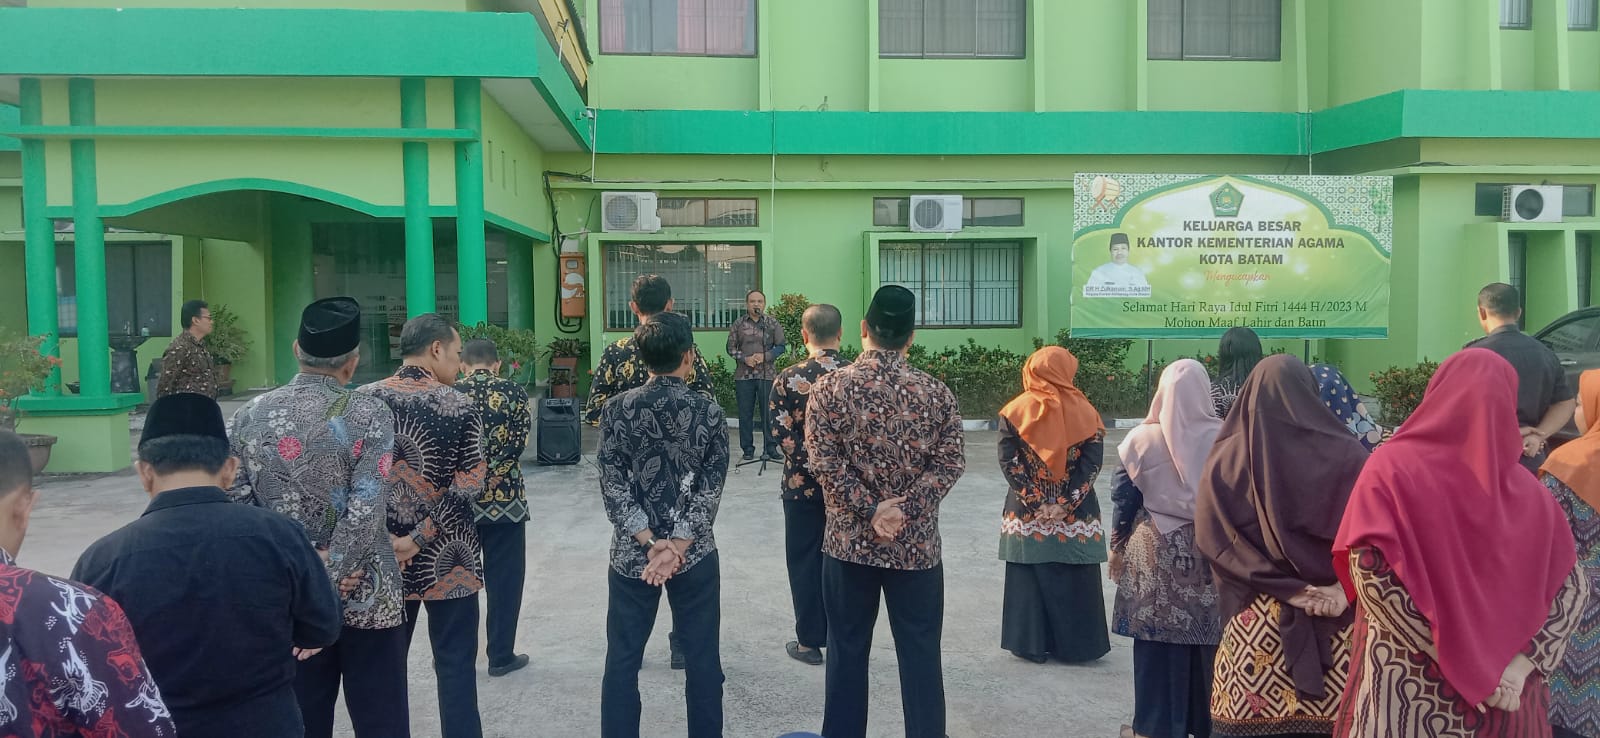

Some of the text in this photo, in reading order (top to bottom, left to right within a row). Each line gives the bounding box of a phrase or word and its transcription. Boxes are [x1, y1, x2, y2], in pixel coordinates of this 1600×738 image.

[1183, 220, 1302, 232] KELUARGA BESAR
[1137, 237, 1345, 248] KANTOR KEMENTERIAN AGAMA
[1199, 254, 1283, 265] KOTA BATAM
[1122, 301, 1367, 314] Selamat Hari Raya Idul Fitri 1444 H/2023 M
[1164, 316, 1326, 328] Mohon Maaf Lahir dan Batin
